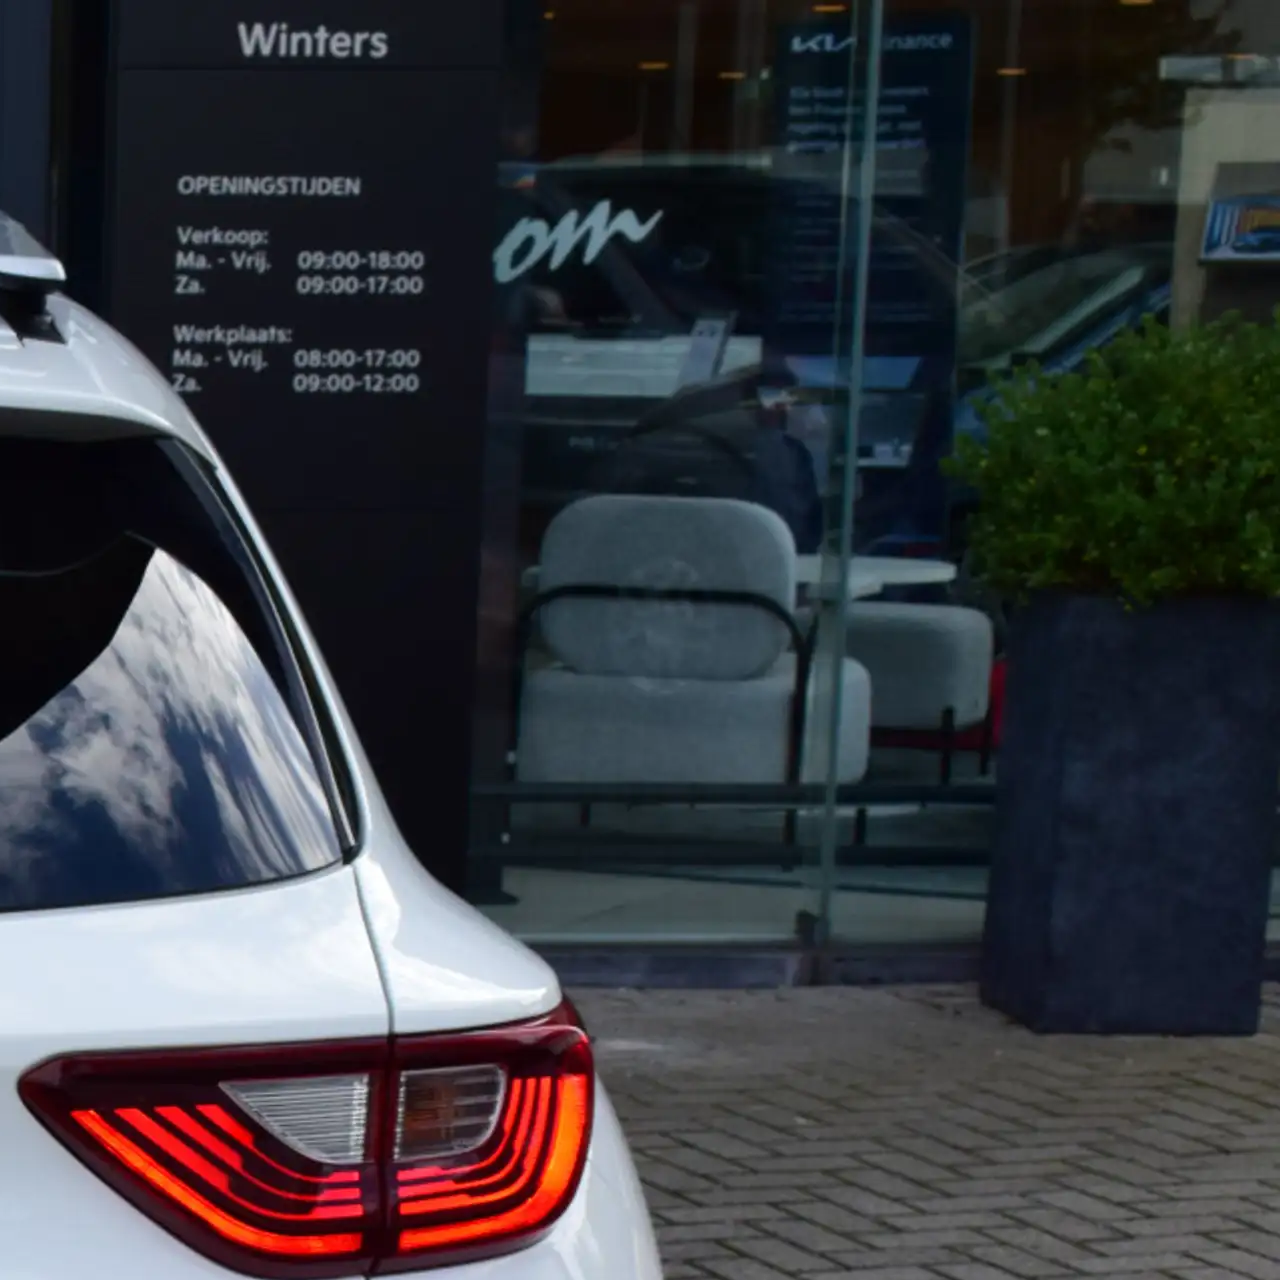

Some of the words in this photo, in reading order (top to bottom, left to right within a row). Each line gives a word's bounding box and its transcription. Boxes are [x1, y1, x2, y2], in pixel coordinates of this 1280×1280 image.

[237, 22, 389, 58] Winters
[177, 175, 362, 196] OPENINGSTIJDEN
[176, 227, 269, 250] Verkoop:
[175, 251, 212, 270] Ma.
[231, 251, 271, 274] Vrij.
[297, 250, 425, 270] 09:00-18:00
[175, 275, 205, 294] Za.
[296, 275, 424, 295] 09:00-17:00
[173, 325, 293, 346] Werkplaats:
[172, 349, 209, 368] Ma.
[227, 349, 268, 372] Vrij.
[293, 349, 421, 368] 08:00-17:00
[172, 374, 201, 392] Za.
[292, 373, 420, 392] 09:00-12:00
